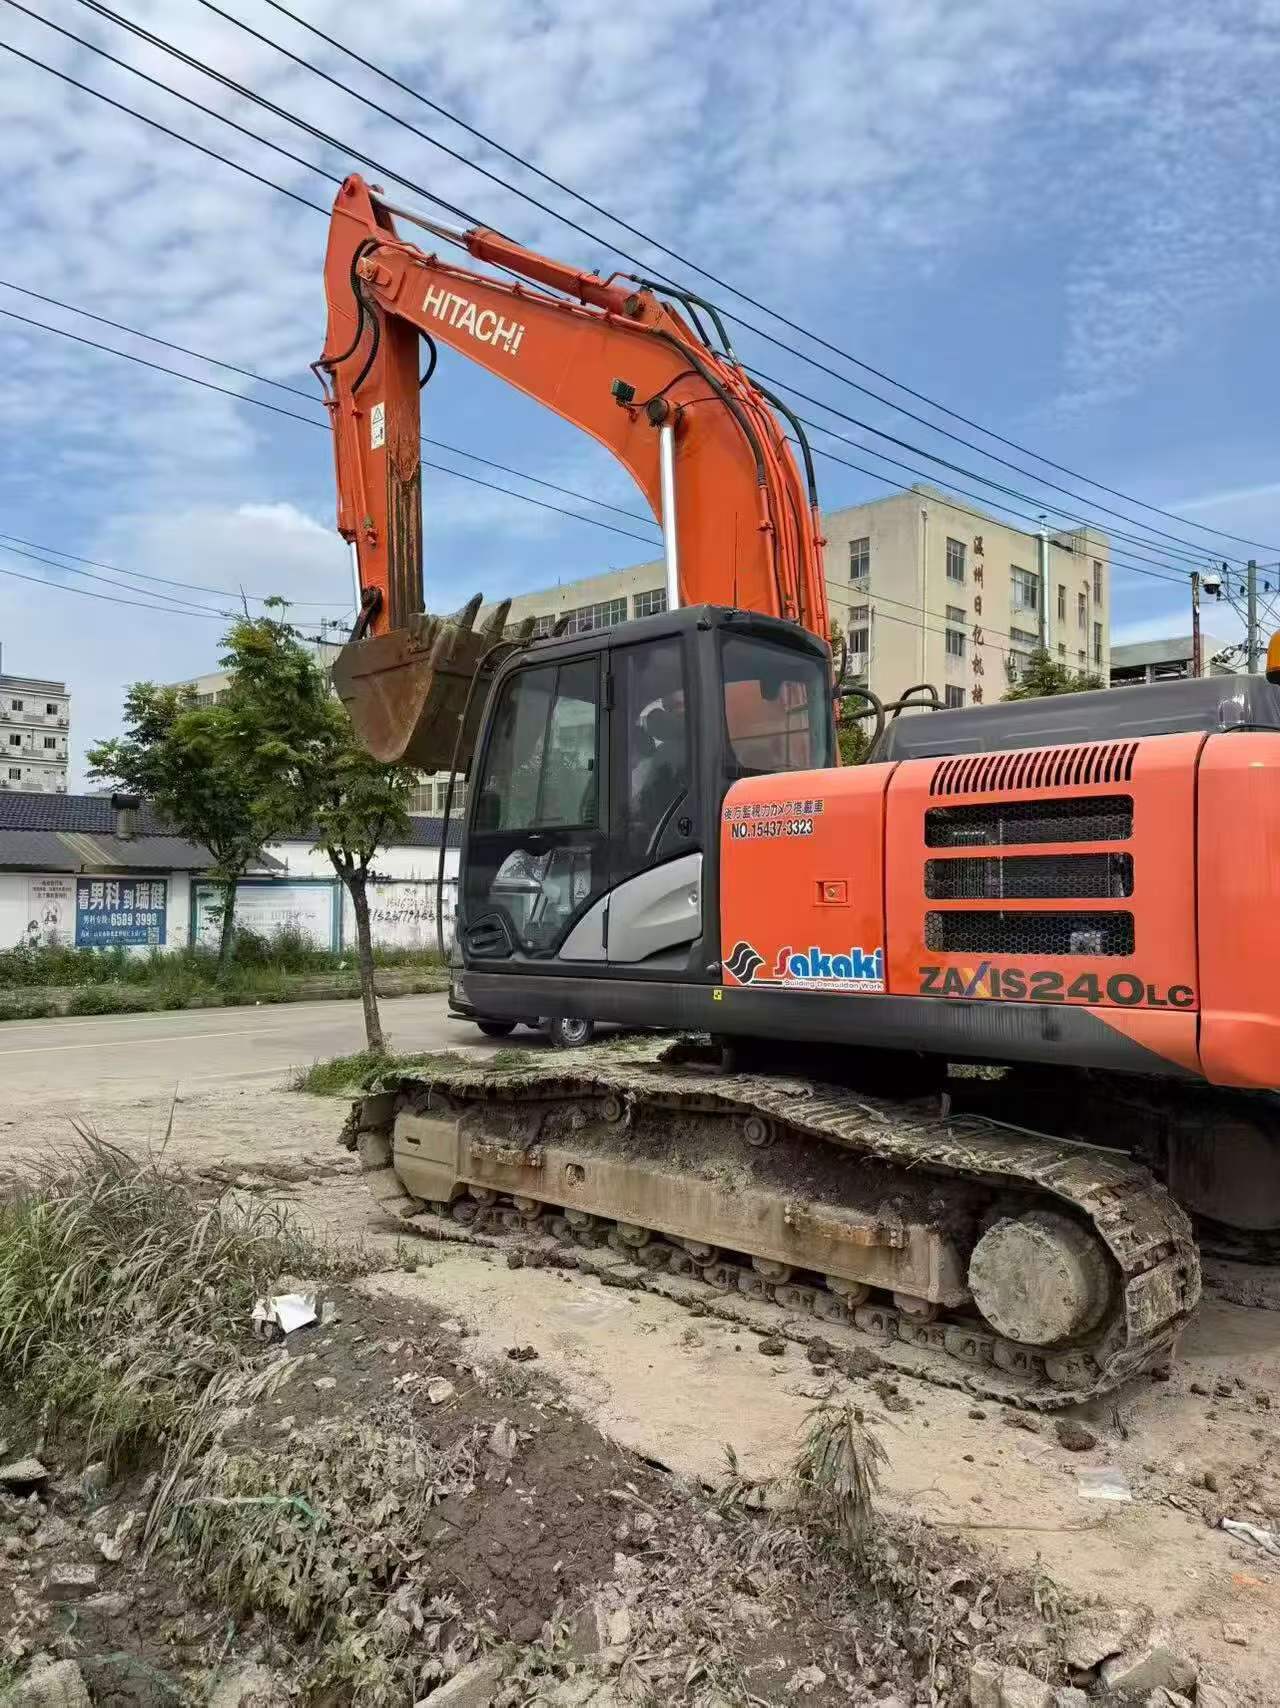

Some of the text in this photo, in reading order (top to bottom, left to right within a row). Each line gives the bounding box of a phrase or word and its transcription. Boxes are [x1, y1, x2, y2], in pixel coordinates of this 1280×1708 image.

[421, 284, 526, 356] HITACHI
[774, 946, 884, 980] Sakaki
[784, 979, 815, 989] Building
[861, 981, 883, 991] Work
